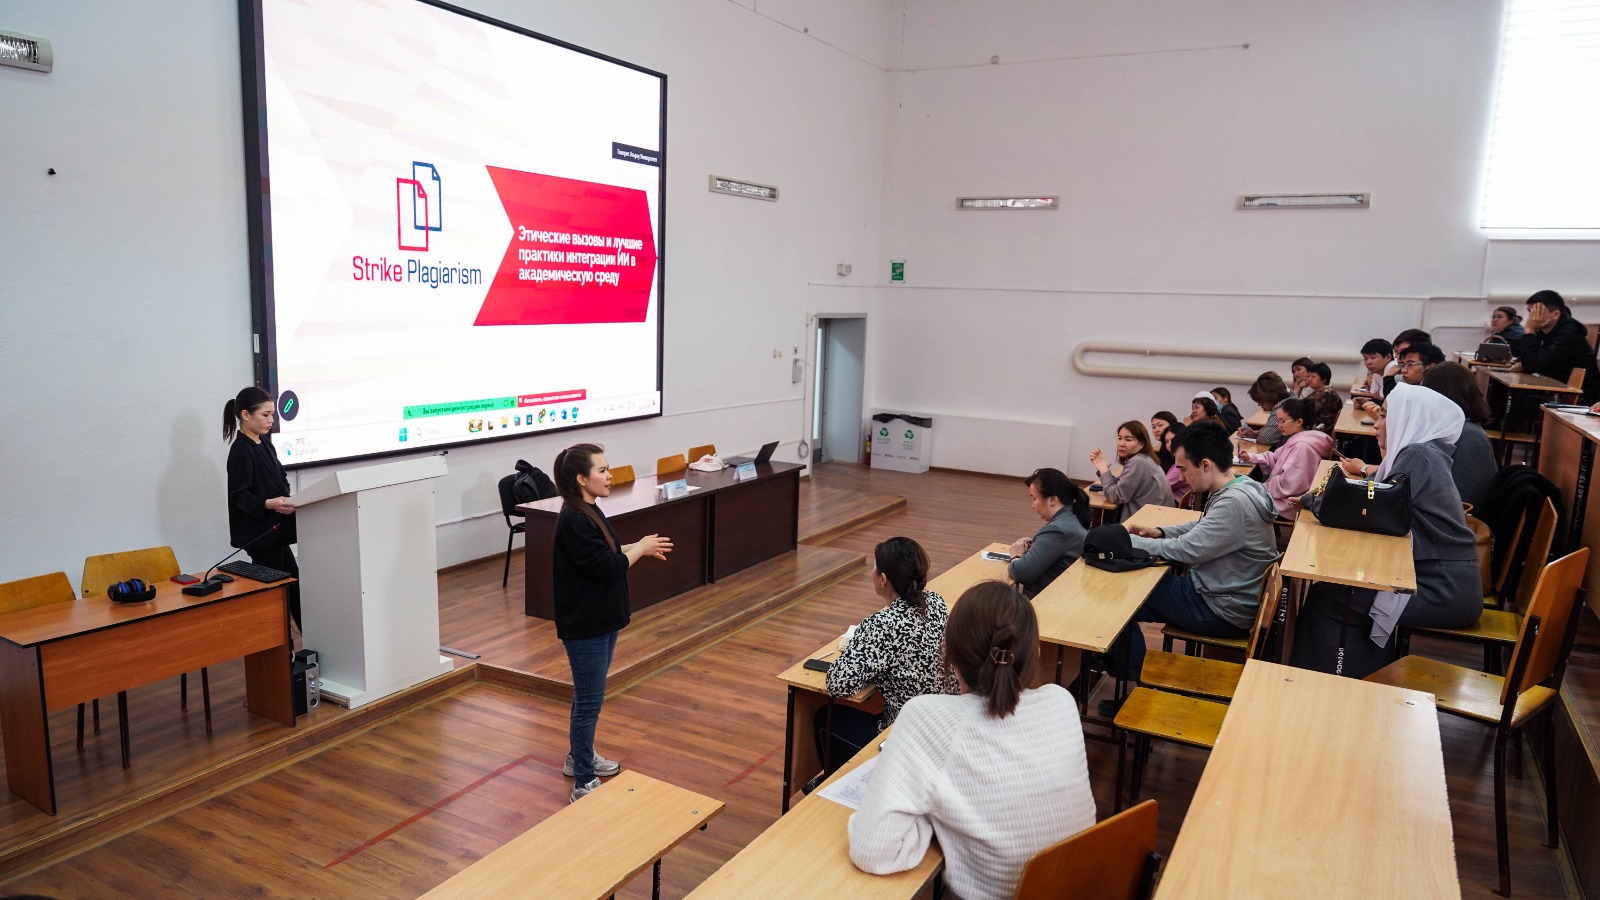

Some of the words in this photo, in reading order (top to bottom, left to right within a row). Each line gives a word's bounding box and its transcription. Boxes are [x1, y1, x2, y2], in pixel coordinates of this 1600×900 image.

[518, 225, 571, 244] Этические
[572, 233, 605, 247] вызовы
[605, 236, 612, 248] и
[613, 237, 643, 252] лучшие
[518, 248, 565, 265] практики
[566, 251, 616, 268] интеграции
[617, 252, 630, 266] ИИ
[631, 255, 636, 267] в
[352, 255, 403, 282] Strike
[407, 259, 482, 289] Plagiarism
[518, 267, 593, 286] академическую
[594, 271, 620, 287] среду
